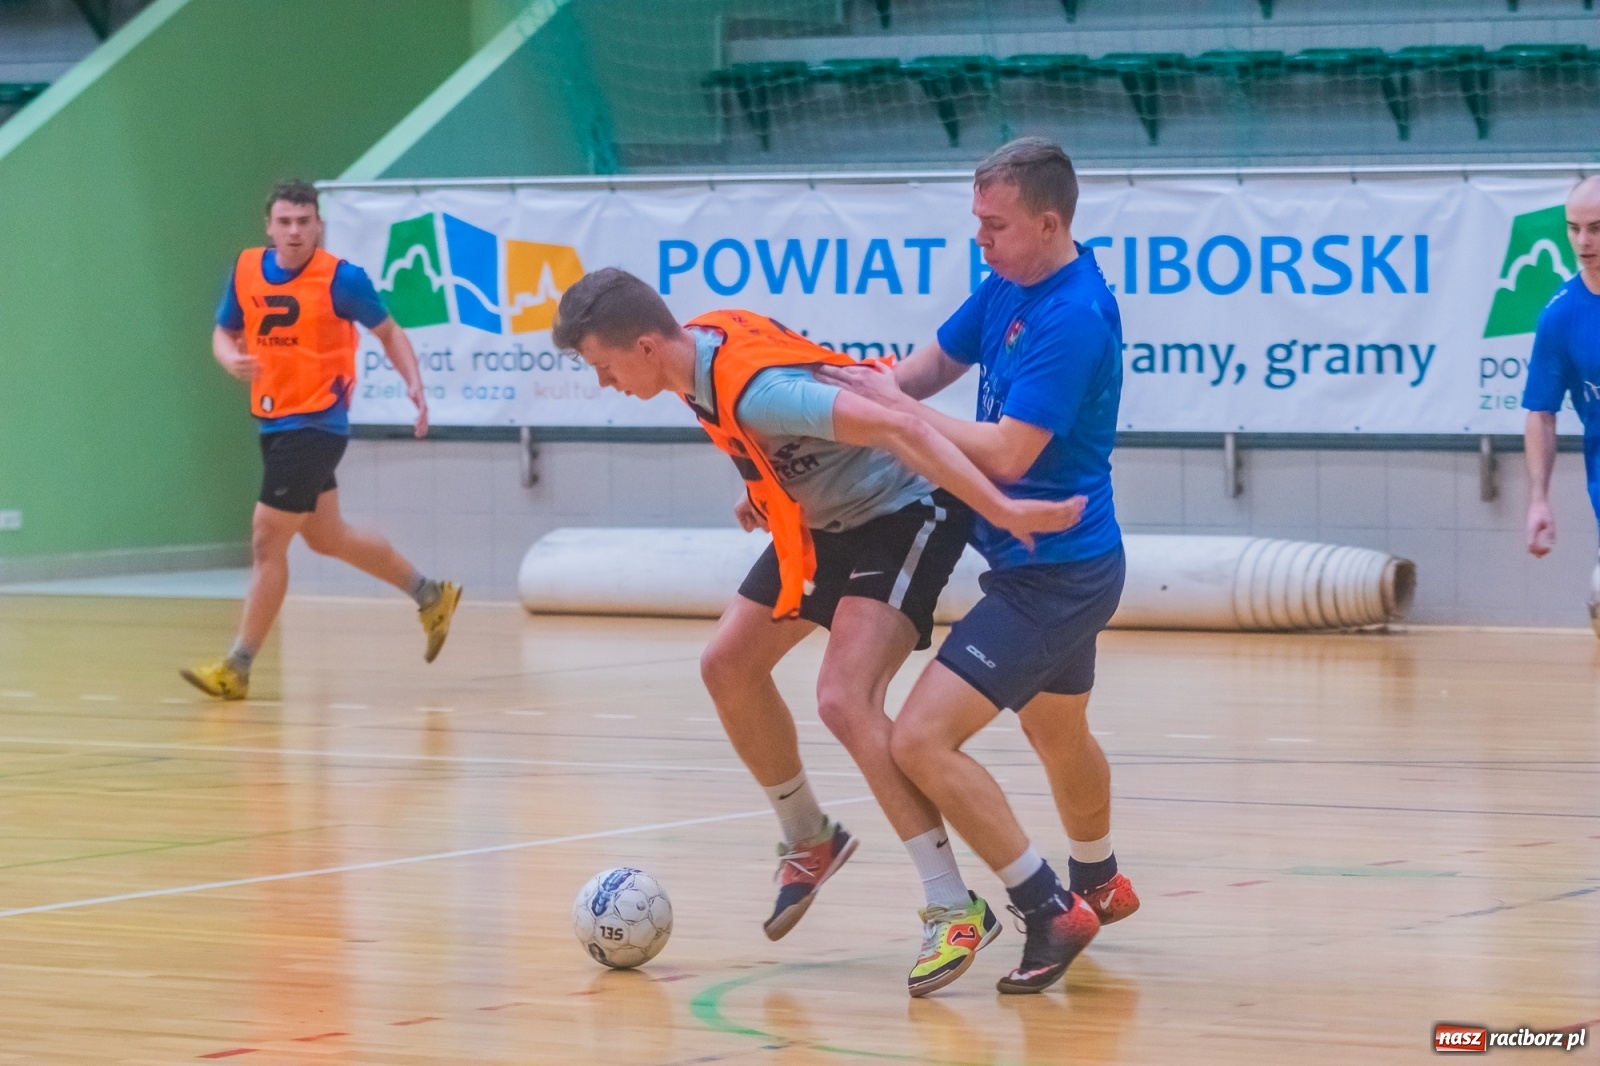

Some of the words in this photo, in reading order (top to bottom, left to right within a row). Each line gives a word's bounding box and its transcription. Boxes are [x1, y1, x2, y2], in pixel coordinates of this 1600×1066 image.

[658, 238, 946, 296] POWIAT
[969, 234, 1429, 296] CIBORSKI
[364, 343, 456, 378] poiat
[1264, 339, 1437, 390] gramy
[462, 385, 516, 399] oaza
